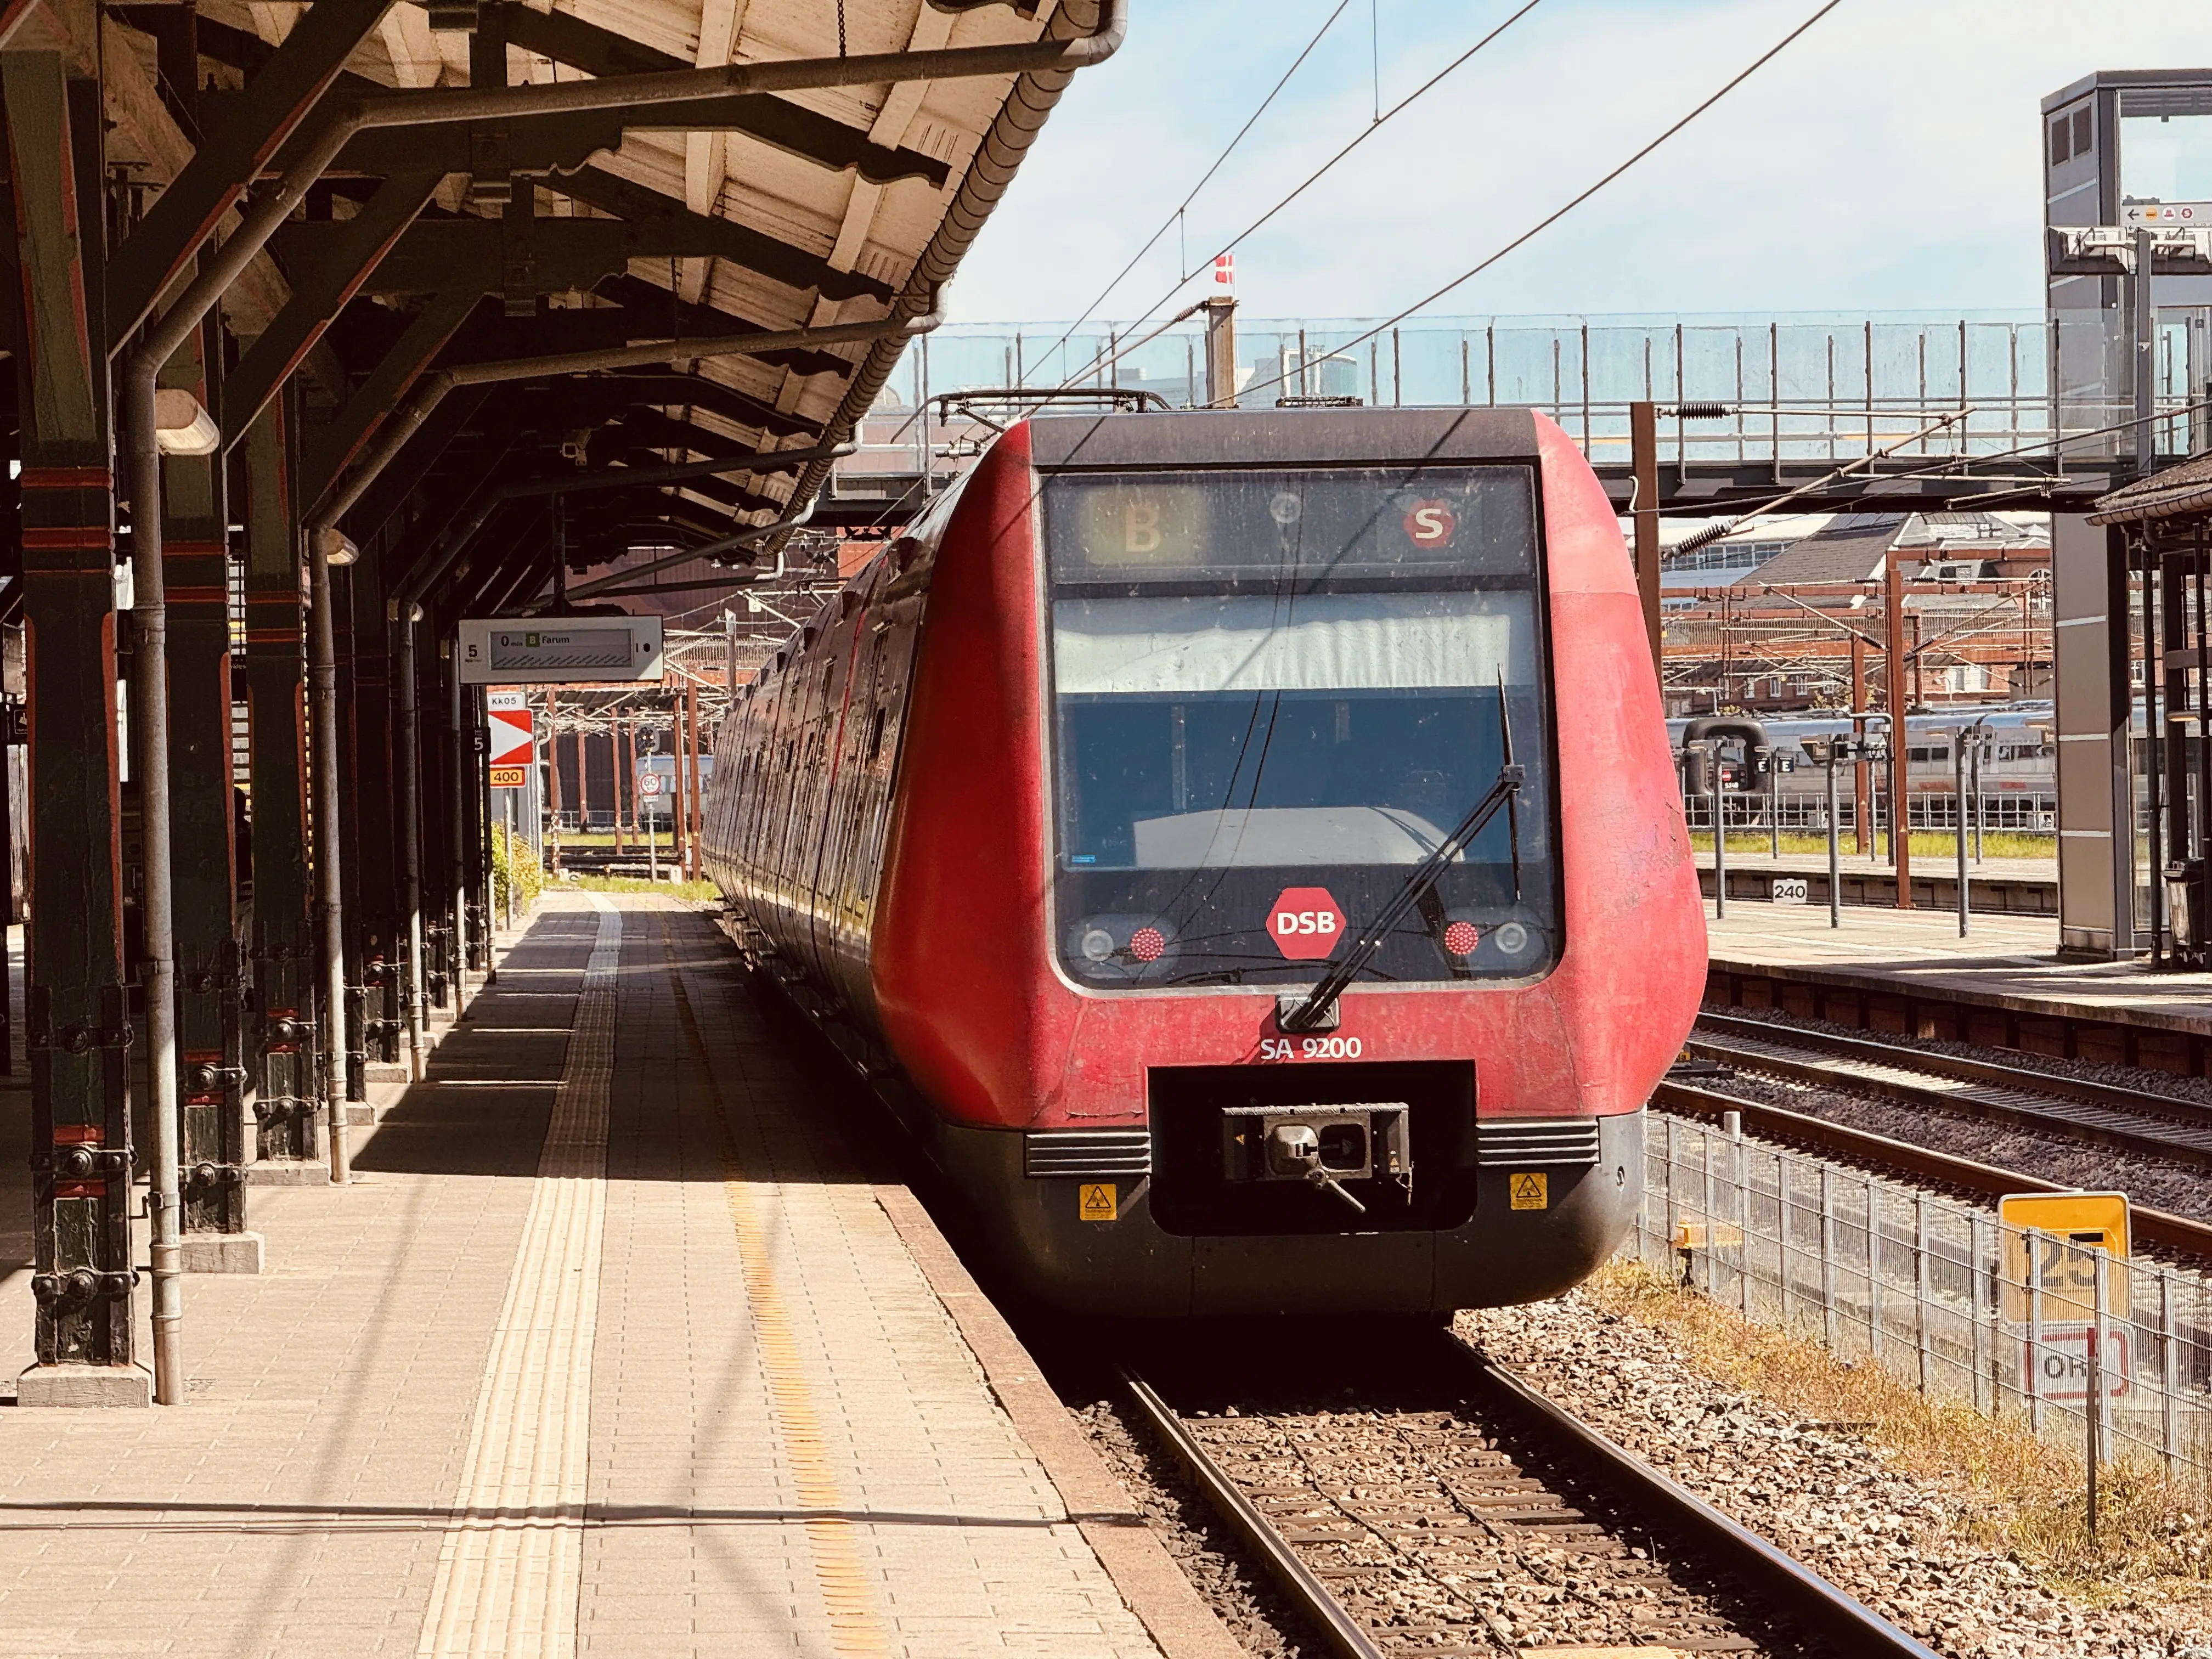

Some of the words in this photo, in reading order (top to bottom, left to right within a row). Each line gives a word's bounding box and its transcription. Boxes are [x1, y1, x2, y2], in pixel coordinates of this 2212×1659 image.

[1126, 505, 1160, 551] B
[1416, 508, 1443, 539] S
[529, 636, 536, 644] B
[469, 645, 478, 657] 5
[475, 737, 483, 750] 5
[1758, 761, 1766, 772] E
[1782, 761, 1790, 772] E
[494, 772, 518, 782] 400
[1775, 885, 1805, 898] 240
[1278, 912, 1335, 934] DSB
[1261, 1039, 1294, 1059] SA
[1302, 1037, 1362, 1058] 9200
